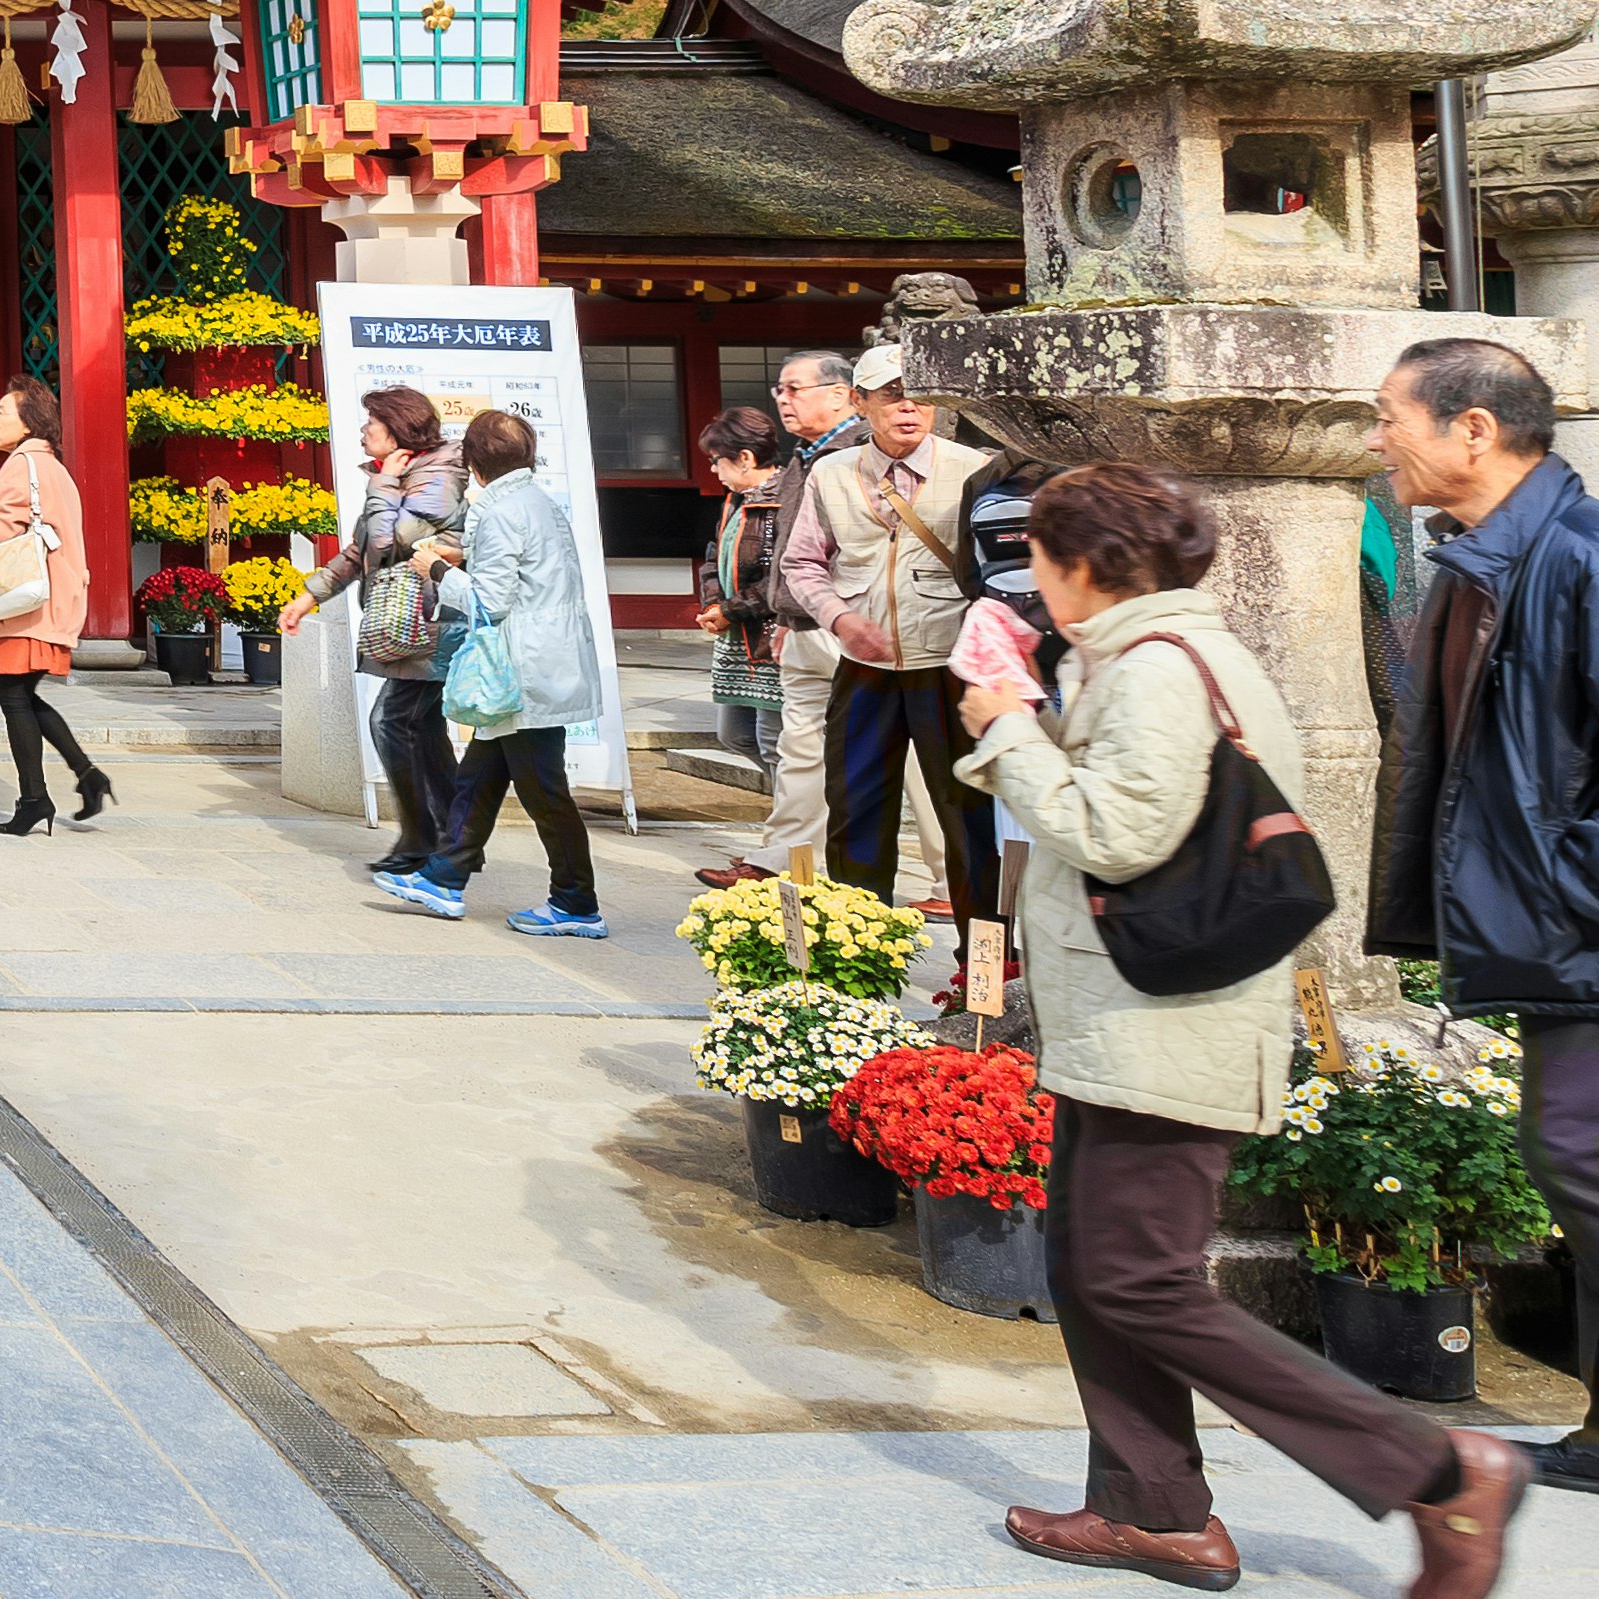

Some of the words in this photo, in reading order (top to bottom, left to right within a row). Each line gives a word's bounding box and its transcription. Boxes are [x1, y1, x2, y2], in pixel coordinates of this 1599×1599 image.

[361, 322, 542, 347] 平成25年大厄年表
[210, 486, 229, 547] 奉納
